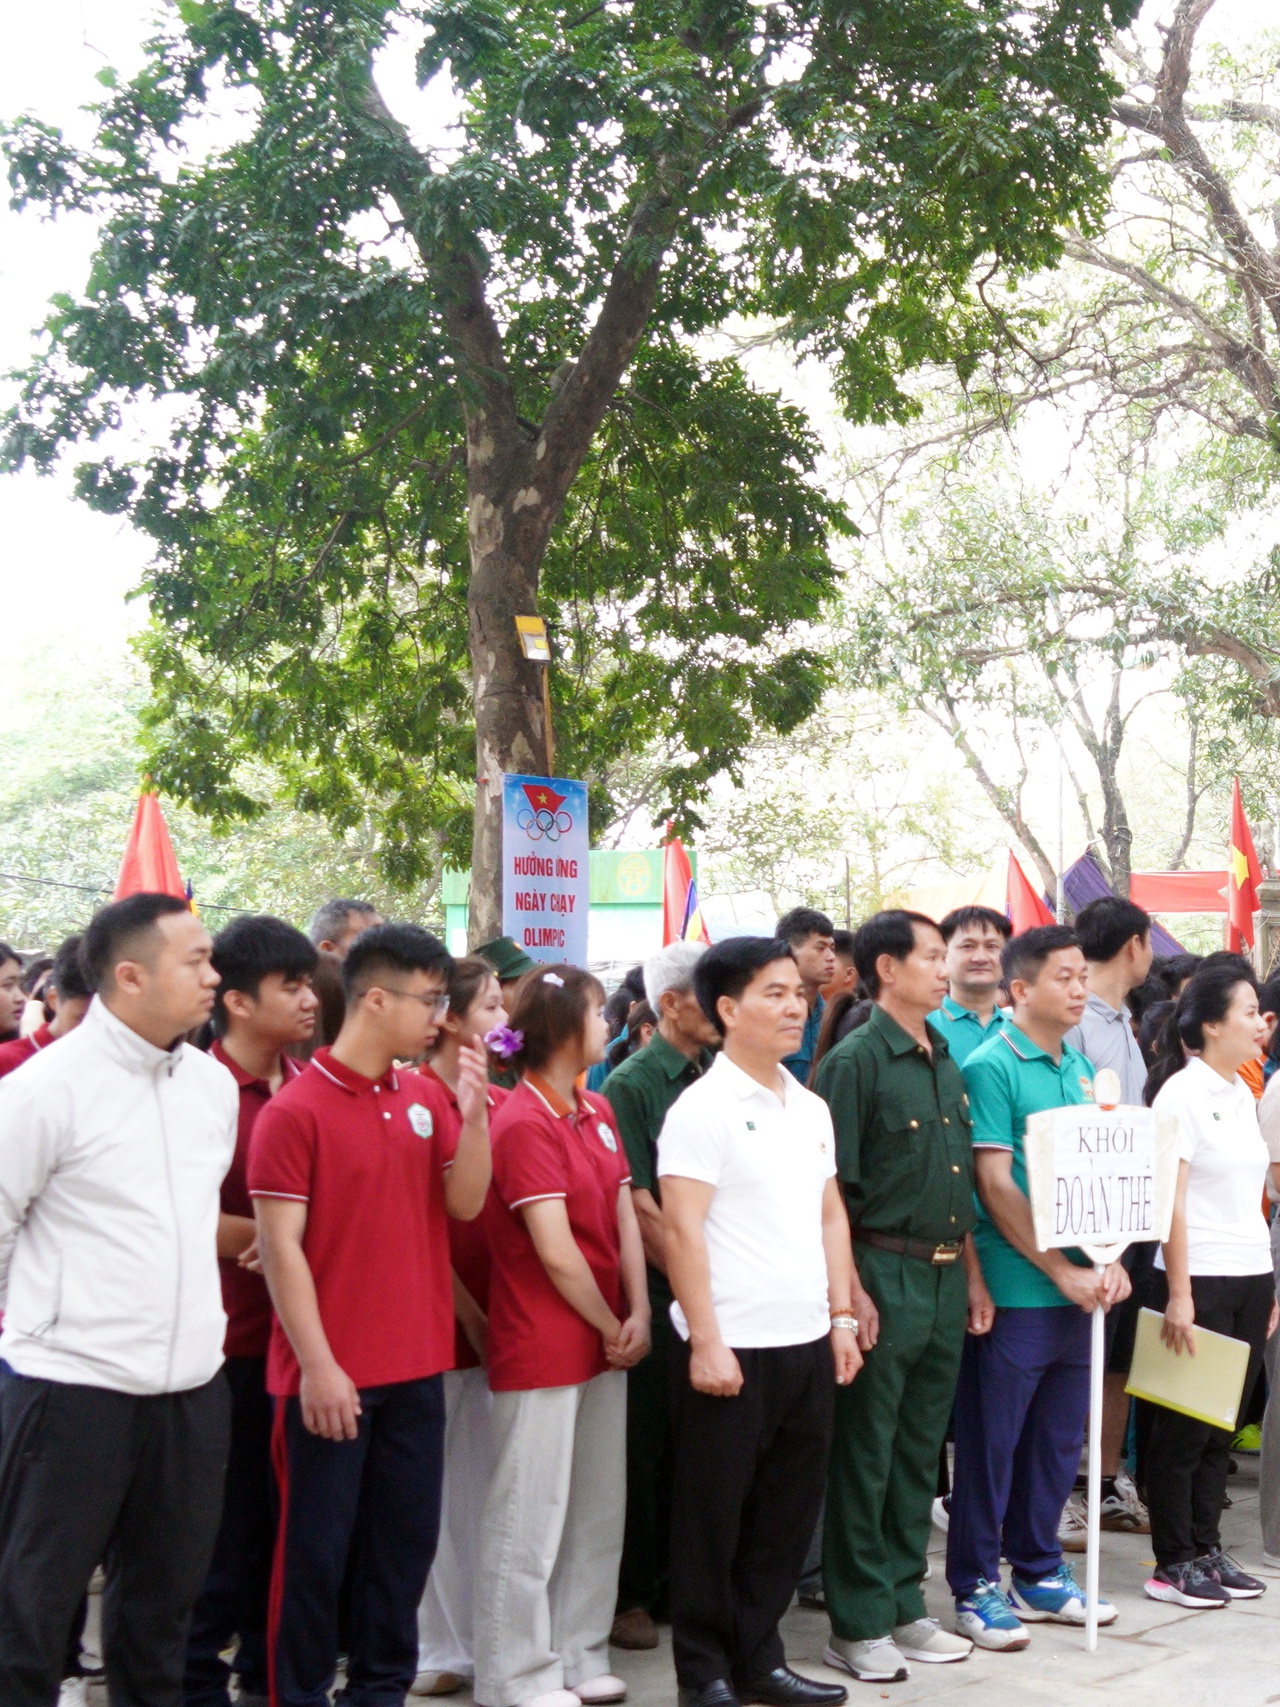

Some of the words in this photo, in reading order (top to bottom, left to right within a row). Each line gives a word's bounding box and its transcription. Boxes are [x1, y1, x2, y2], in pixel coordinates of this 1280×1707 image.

[514, 851, 553, 877] HƯỞNG
[515, 889, 546, 912] NGÀY
[550, 892, 576, 917] CHẠY
[524, 927, 565, 948] OLIMPIC
[1078, 1119, 1134, 1153] KHỐI
[1055, 1158, 1112, 1235] ĐOÀN
